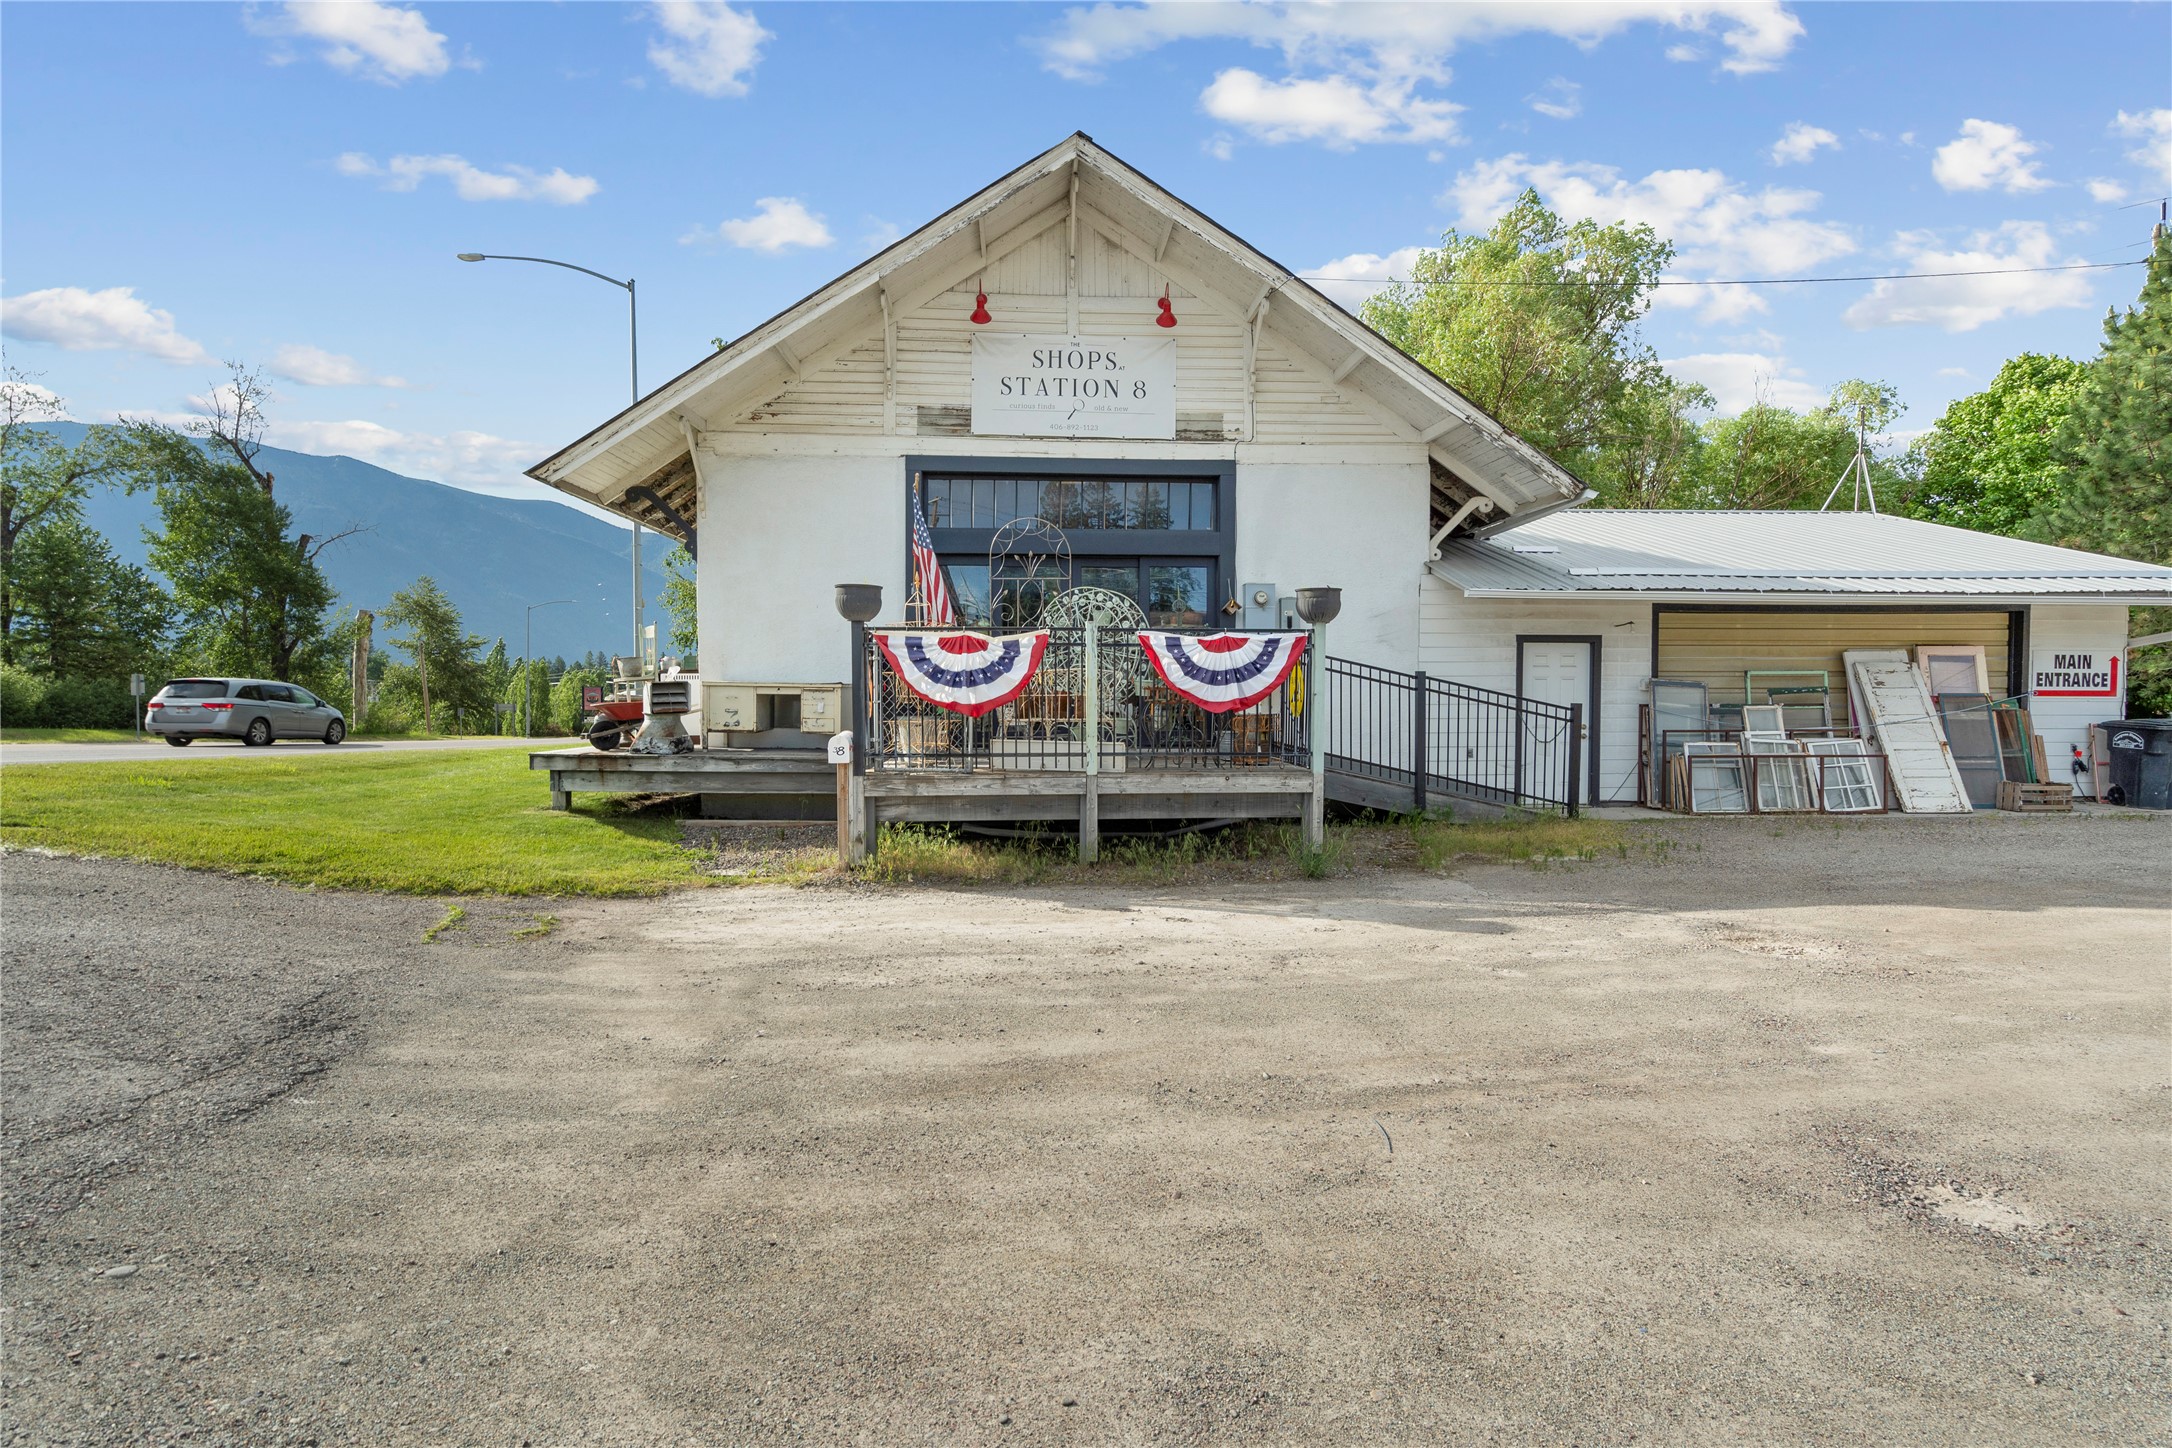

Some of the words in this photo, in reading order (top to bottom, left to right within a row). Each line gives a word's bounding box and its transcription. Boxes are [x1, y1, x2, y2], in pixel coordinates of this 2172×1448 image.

[1032, 349, 1117, 371] SHOPS
[1000, 376, 1119, 399] STATION
[1133, 379, 1147, 399] 8
[1049, 423, 1099, 431] 406-892-1123
[2054, 654, 2092, 670] MAIN
[2036, 672, 2109, 688] ENTRANCE
